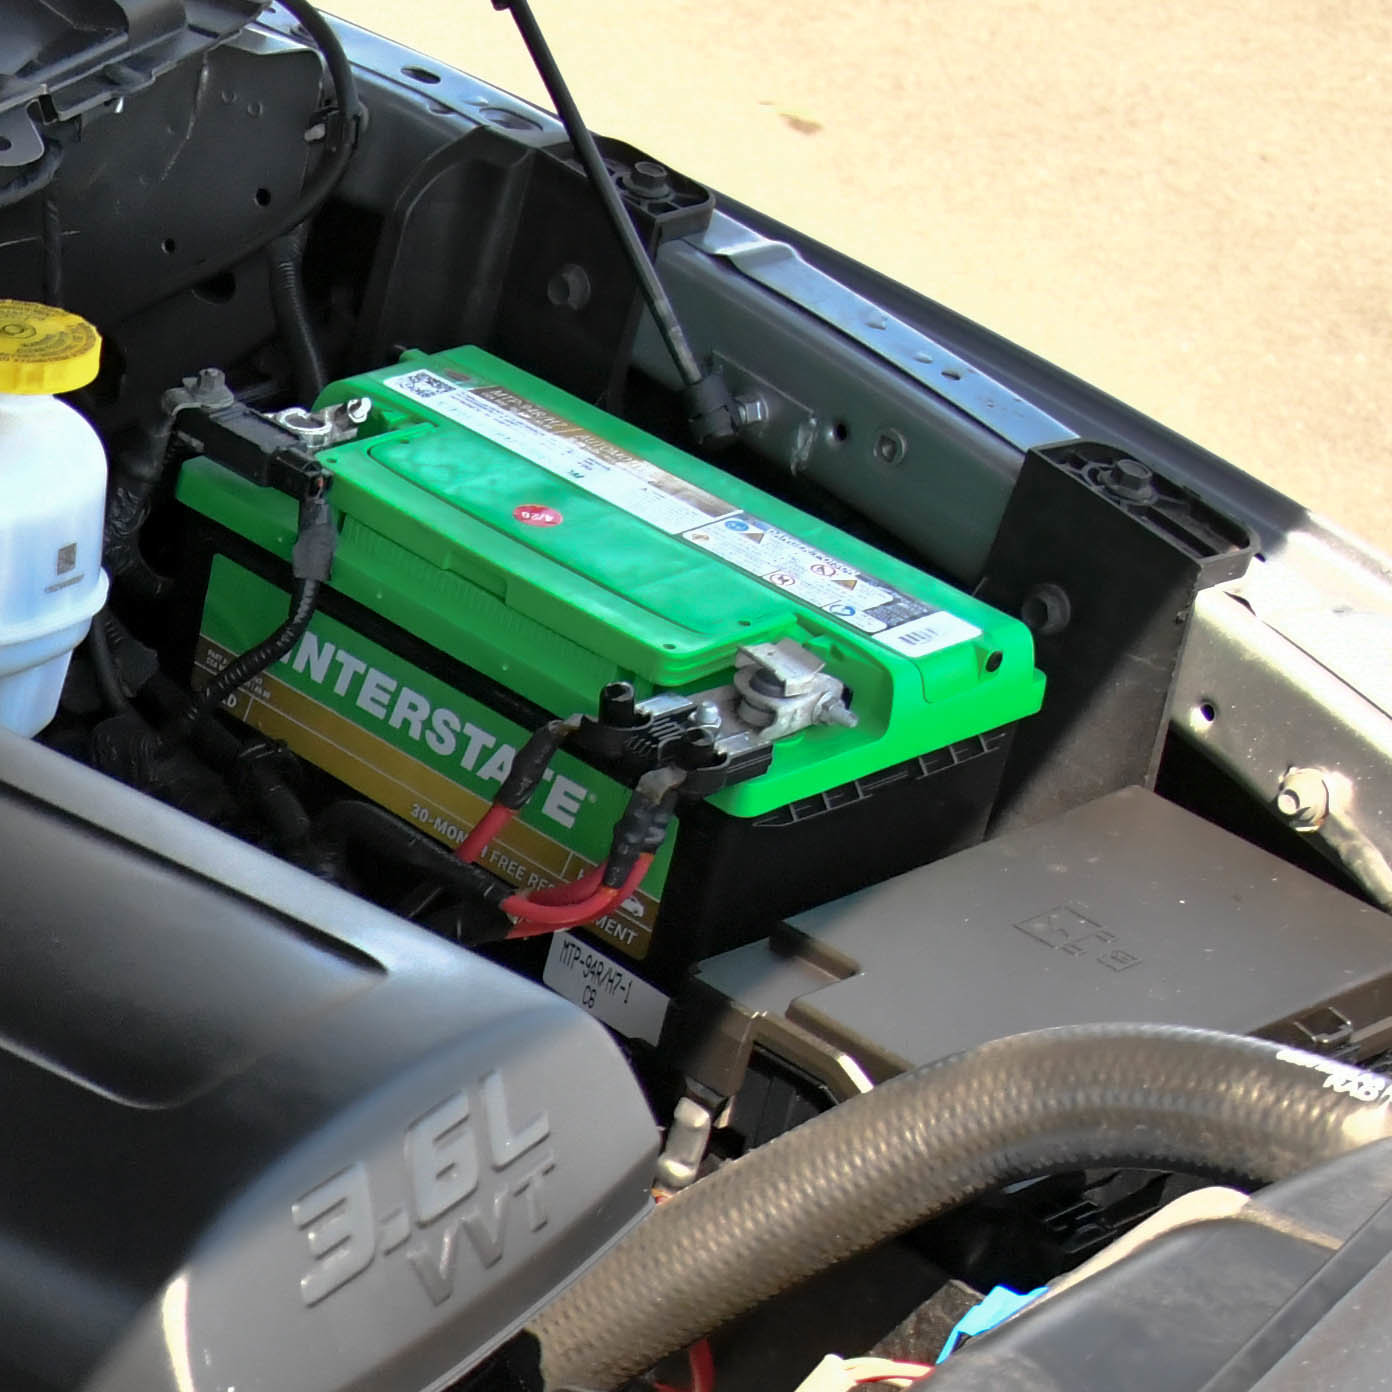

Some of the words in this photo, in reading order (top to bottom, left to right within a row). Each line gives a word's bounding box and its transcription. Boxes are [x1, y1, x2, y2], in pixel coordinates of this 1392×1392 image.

[279, 630, 588, 830] NTERSTAE
[488, 847, 527, 881] FREE
[291, 1069, 551, 1309] 3.6L
[406, 1150, 559, 1307] VVT
